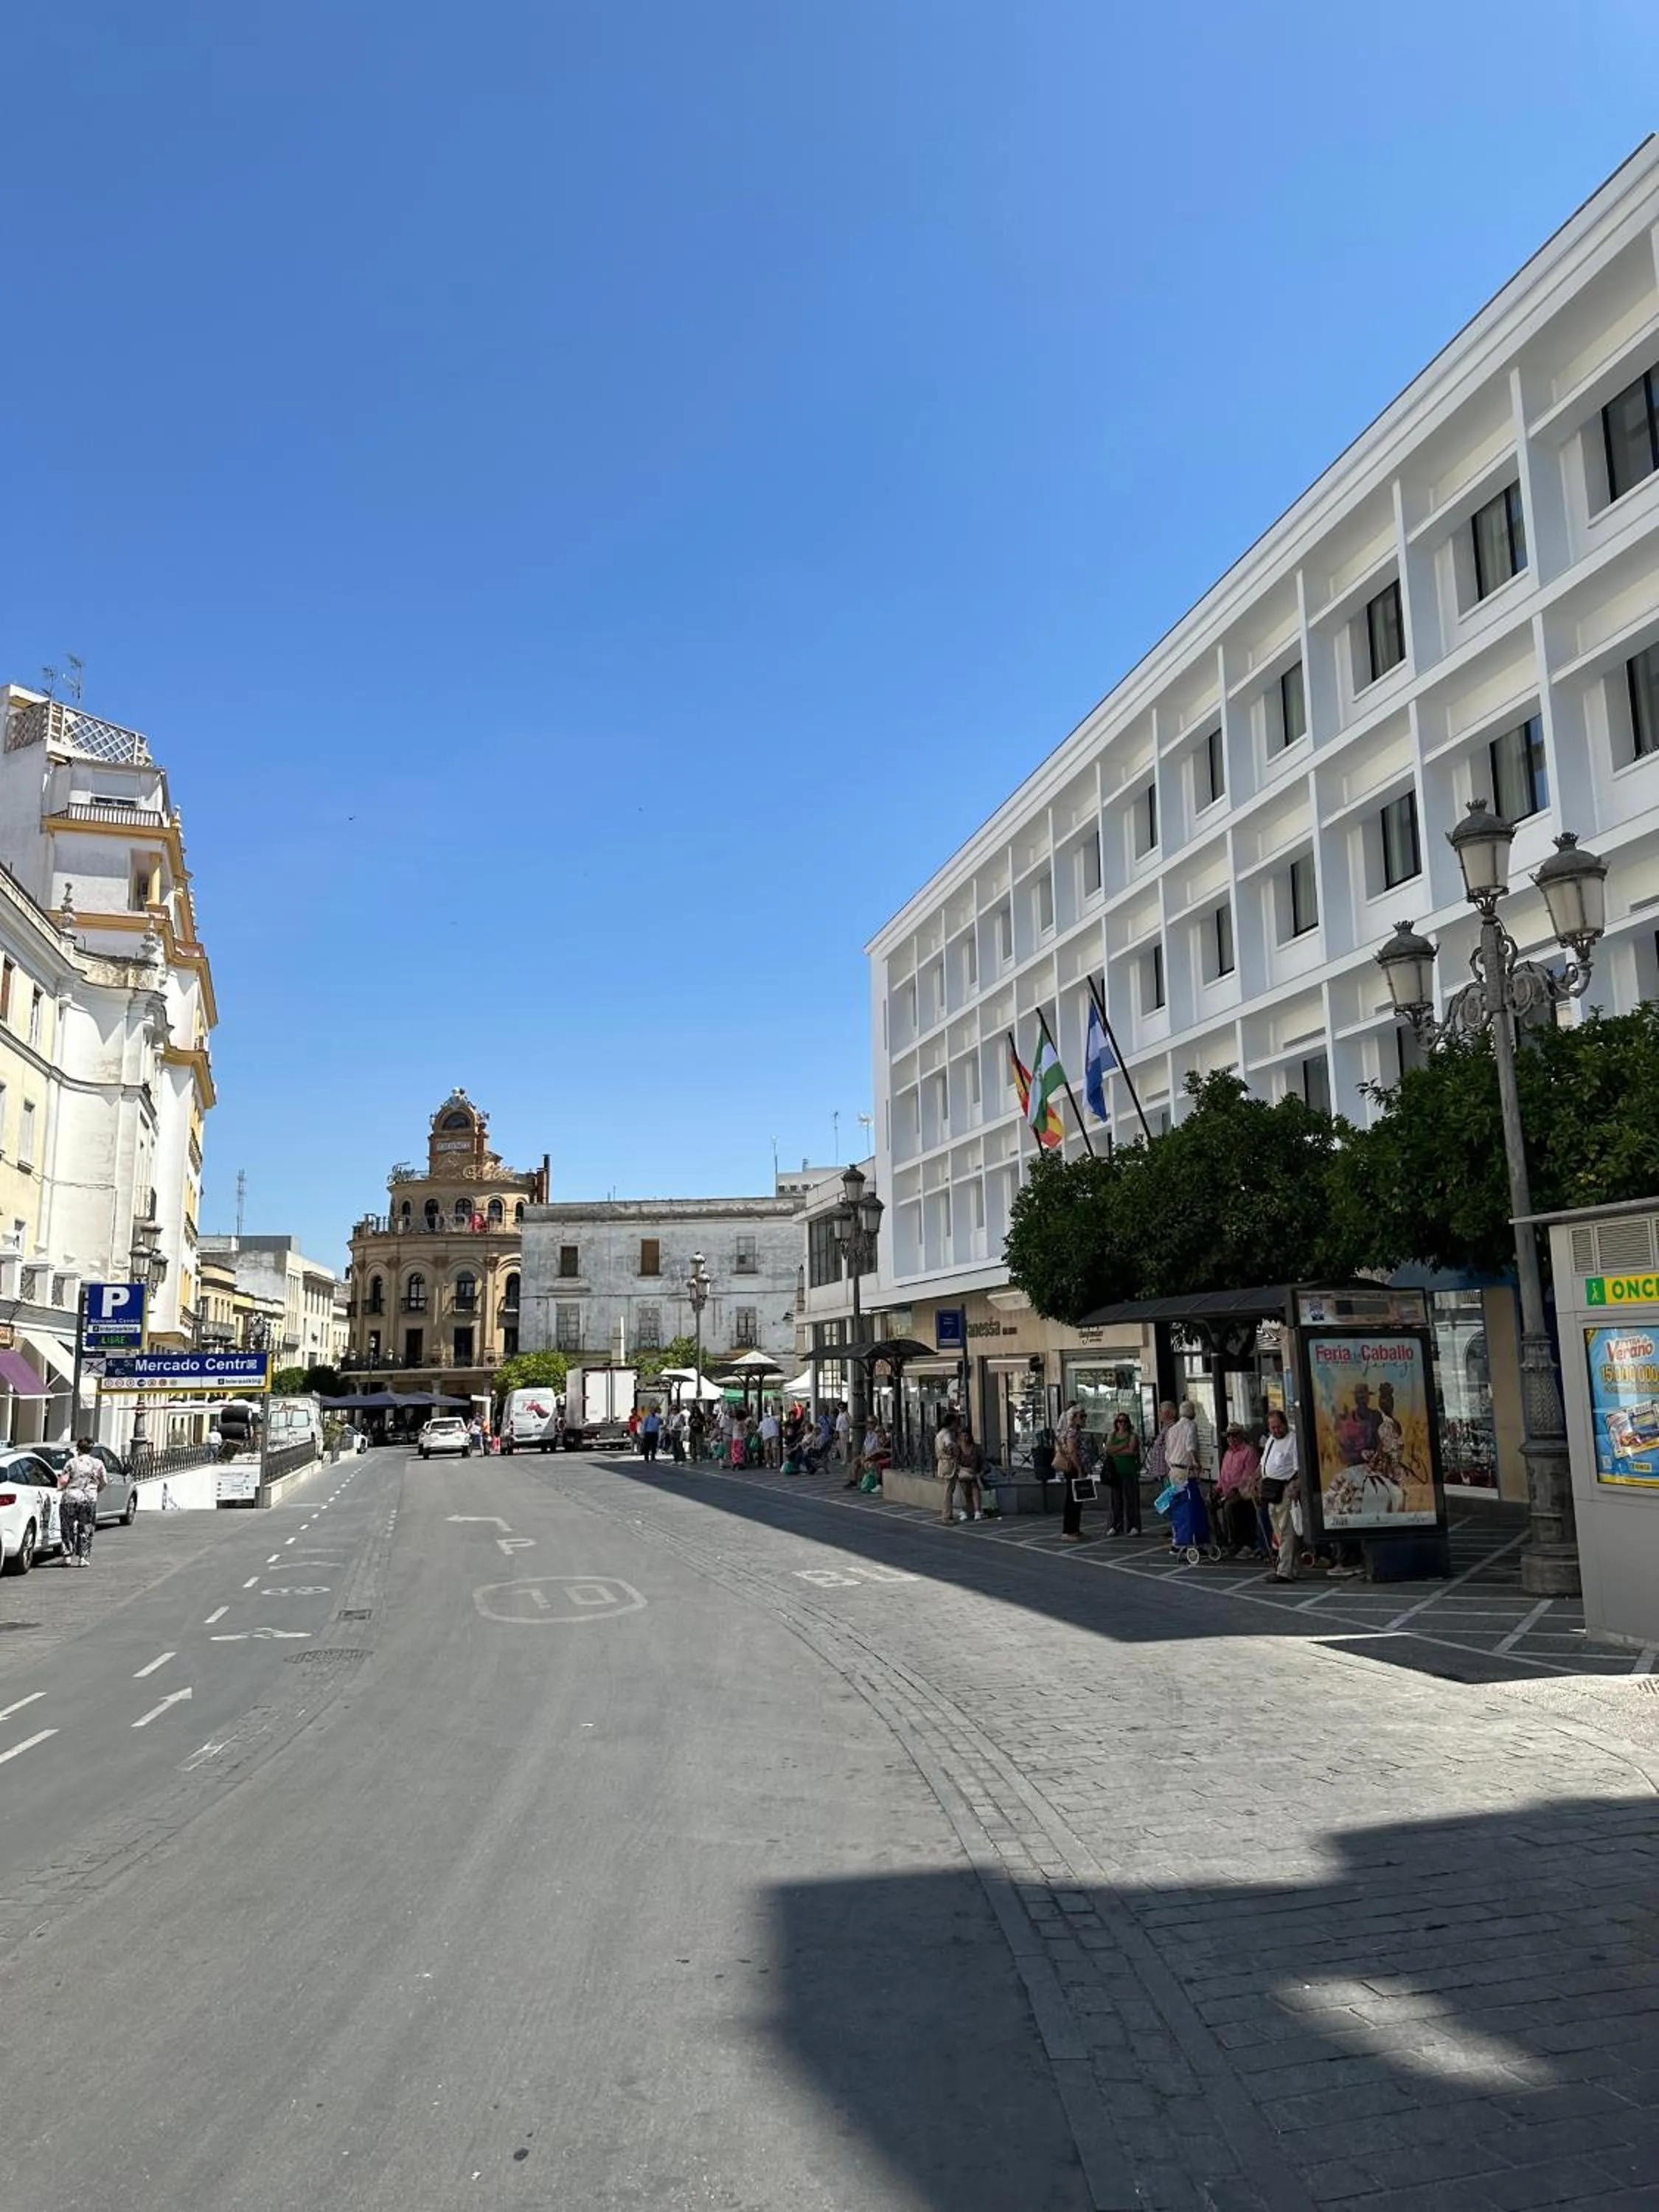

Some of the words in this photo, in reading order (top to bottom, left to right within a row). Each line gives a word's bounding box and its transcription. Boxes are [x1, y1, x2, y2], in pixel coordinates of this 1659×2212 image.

[1612, 1277, 1659, 1300] ONC
[102, 1287, 130, 1318] P
[101, 1335, 126, 1345] LIBRE
[1315, 1345, 1352, 1361] Feria
[1360, 1345, 1414, 1361] Caballo
[1606, 1340, 1653, 1363] Verano
[135, 1358, 200, 1371] Mercado
[495, 1538, 538, 1555] P
